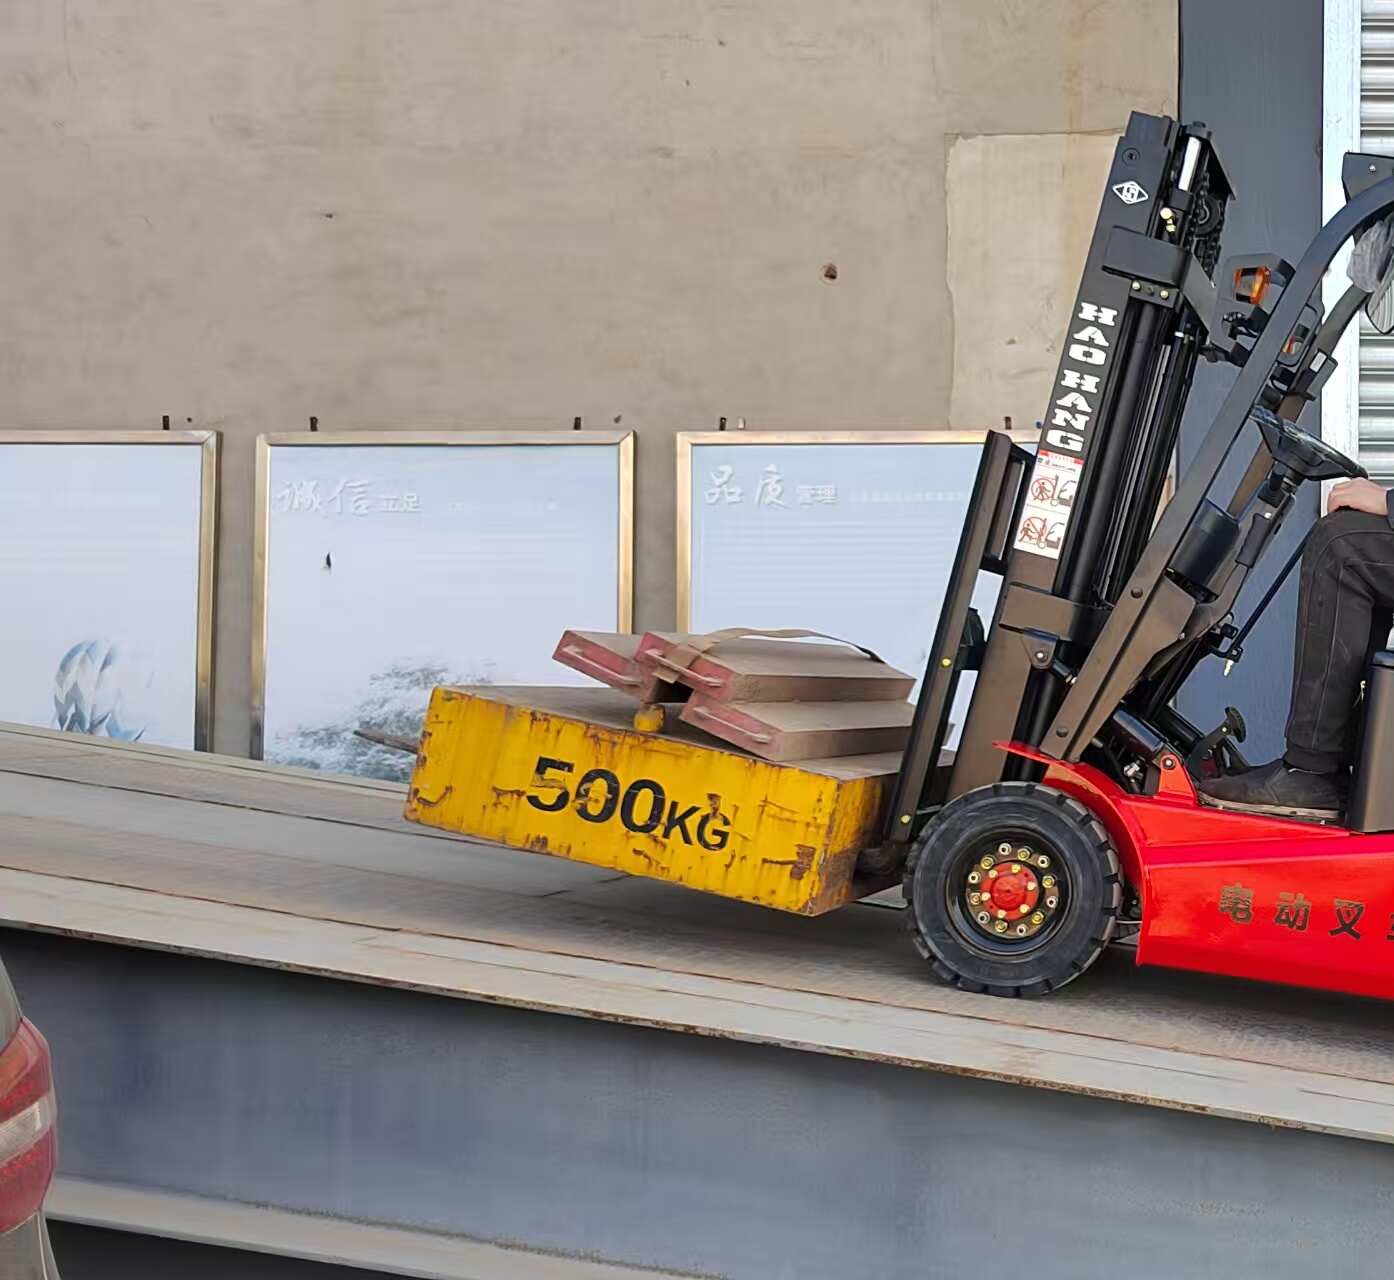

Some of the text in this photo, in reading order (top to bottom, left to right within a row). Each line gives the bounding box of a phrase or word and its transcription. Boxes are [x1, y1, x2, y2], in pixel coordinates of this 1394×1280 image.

[1069, 302, 1118, 365] HAO
[1046, 369, 1100, 452] HANG
[526, 756, 732, 851] 500KG
